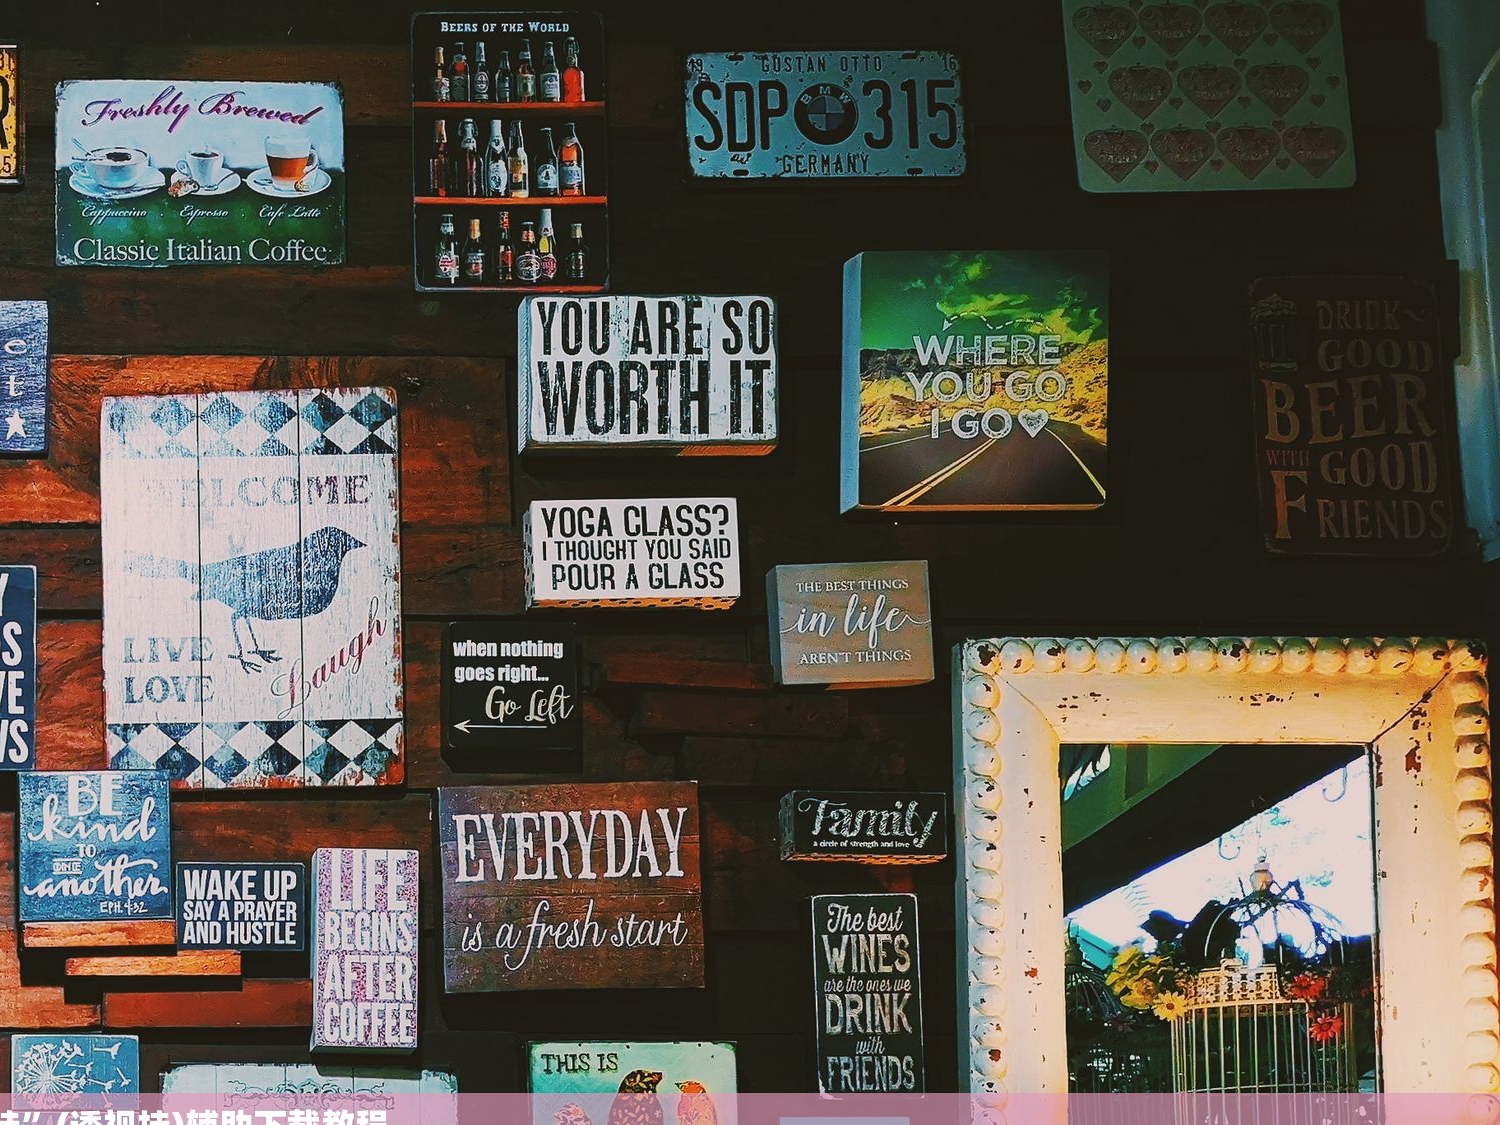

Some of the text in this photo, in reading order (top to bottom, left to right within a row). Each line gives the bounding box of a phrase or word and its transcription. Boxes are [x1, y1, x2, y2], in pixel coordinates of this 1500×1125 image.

[441, 22, 569, 33] BEERS OF THE WORLD
[82, 86, 325, 134] Freshly Brewed
[693, 79, 957, 152] SDP 315
[783, 154, 869, 174] GERMANY
[74, 237, 327, 263] Classic Italian Coffee
[538, 301, 770, 355] YOU ARE SO
[912, 333, 1062, 366] WHERE
[538, 360, 771, 437] WORTH IT
[911, 369, 1066, 402] YOU GO
[931, 407, 1013, 439] I GO
[1260, 373, 1436, 445] BEER
[542, 505, 729, 539] YOGA CLASS?
[1271, 470, 1446, 539] FRIENDS
[542, 539, 731, 561] I THOUGHT YOU SAID
[552, 563, 724, 591] POUR A GLASS
[453, 640, 564, 661] when nothing
[454, 663, 549, 684] goes right...
[485, 684, 573, 723] Go Left
[67, 774, 123, 816] BE
[798, 797, 938, 848] Family
[453, 808, 687, 884] EVERYDAY
[183, 870, 297, 901] WAKE UP
[184, 922, 297, 945] AND HUSTLE
[325, 912, 412, 952] BEGINS
[463, 900, 687, 971] is a fresh start
[822, 934, 911, 974] WINES
[325, 956, 413, 1002] AFTER
[324, 1003, 415, 1044] COFFEE
[825, 993, 913, 1034] DRINK
[827, 1055, 915, 1092] FRIENDS
